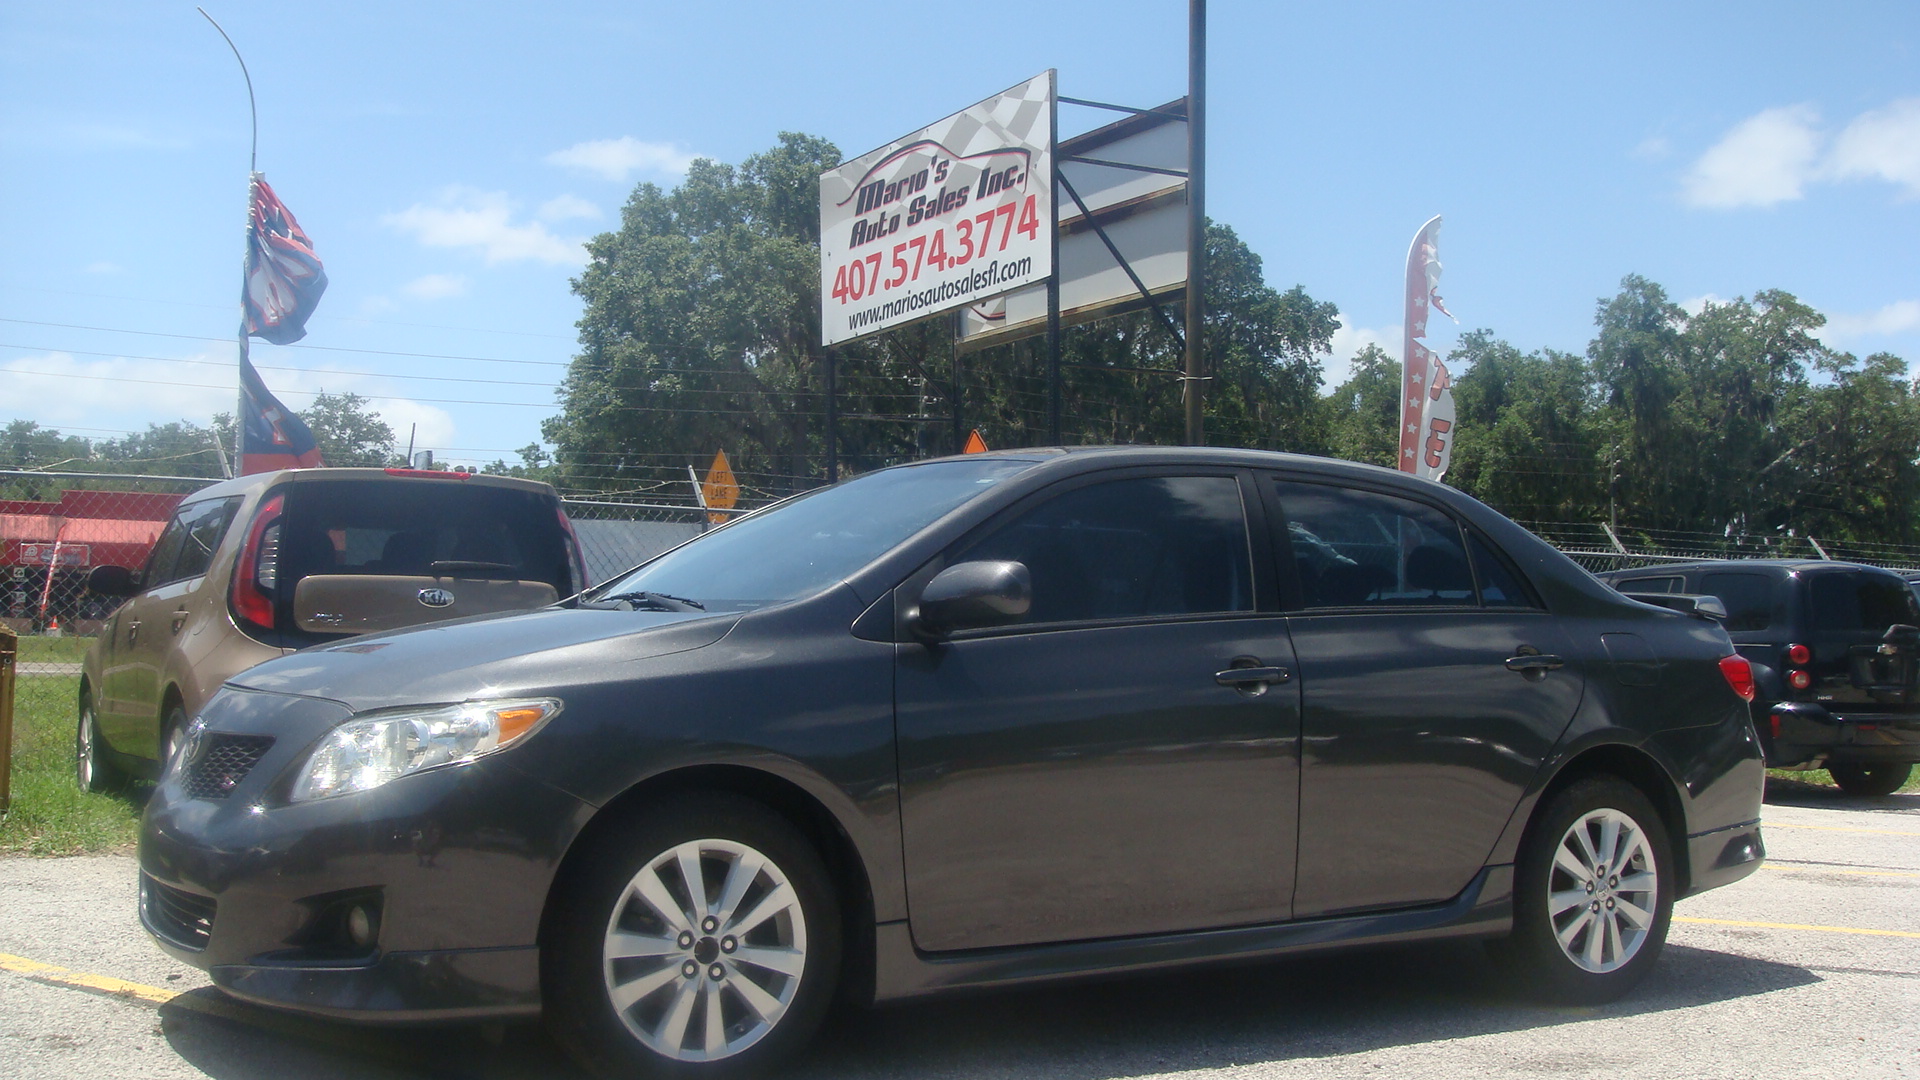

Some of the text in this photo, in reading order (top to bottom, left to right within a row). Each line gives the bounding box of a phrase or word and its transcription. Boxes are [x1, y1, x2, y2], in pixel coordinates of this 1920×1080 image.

[849, 165, 1025, 250] Auto Sales Inc.
[854, 154, 950, 217] Mario's
[832, 194, 1040, 305] 407.574.3774
[848, 256, 1031, 331] www.mariosautosalesfl.com
[422, 590, 454, 606] KIA
